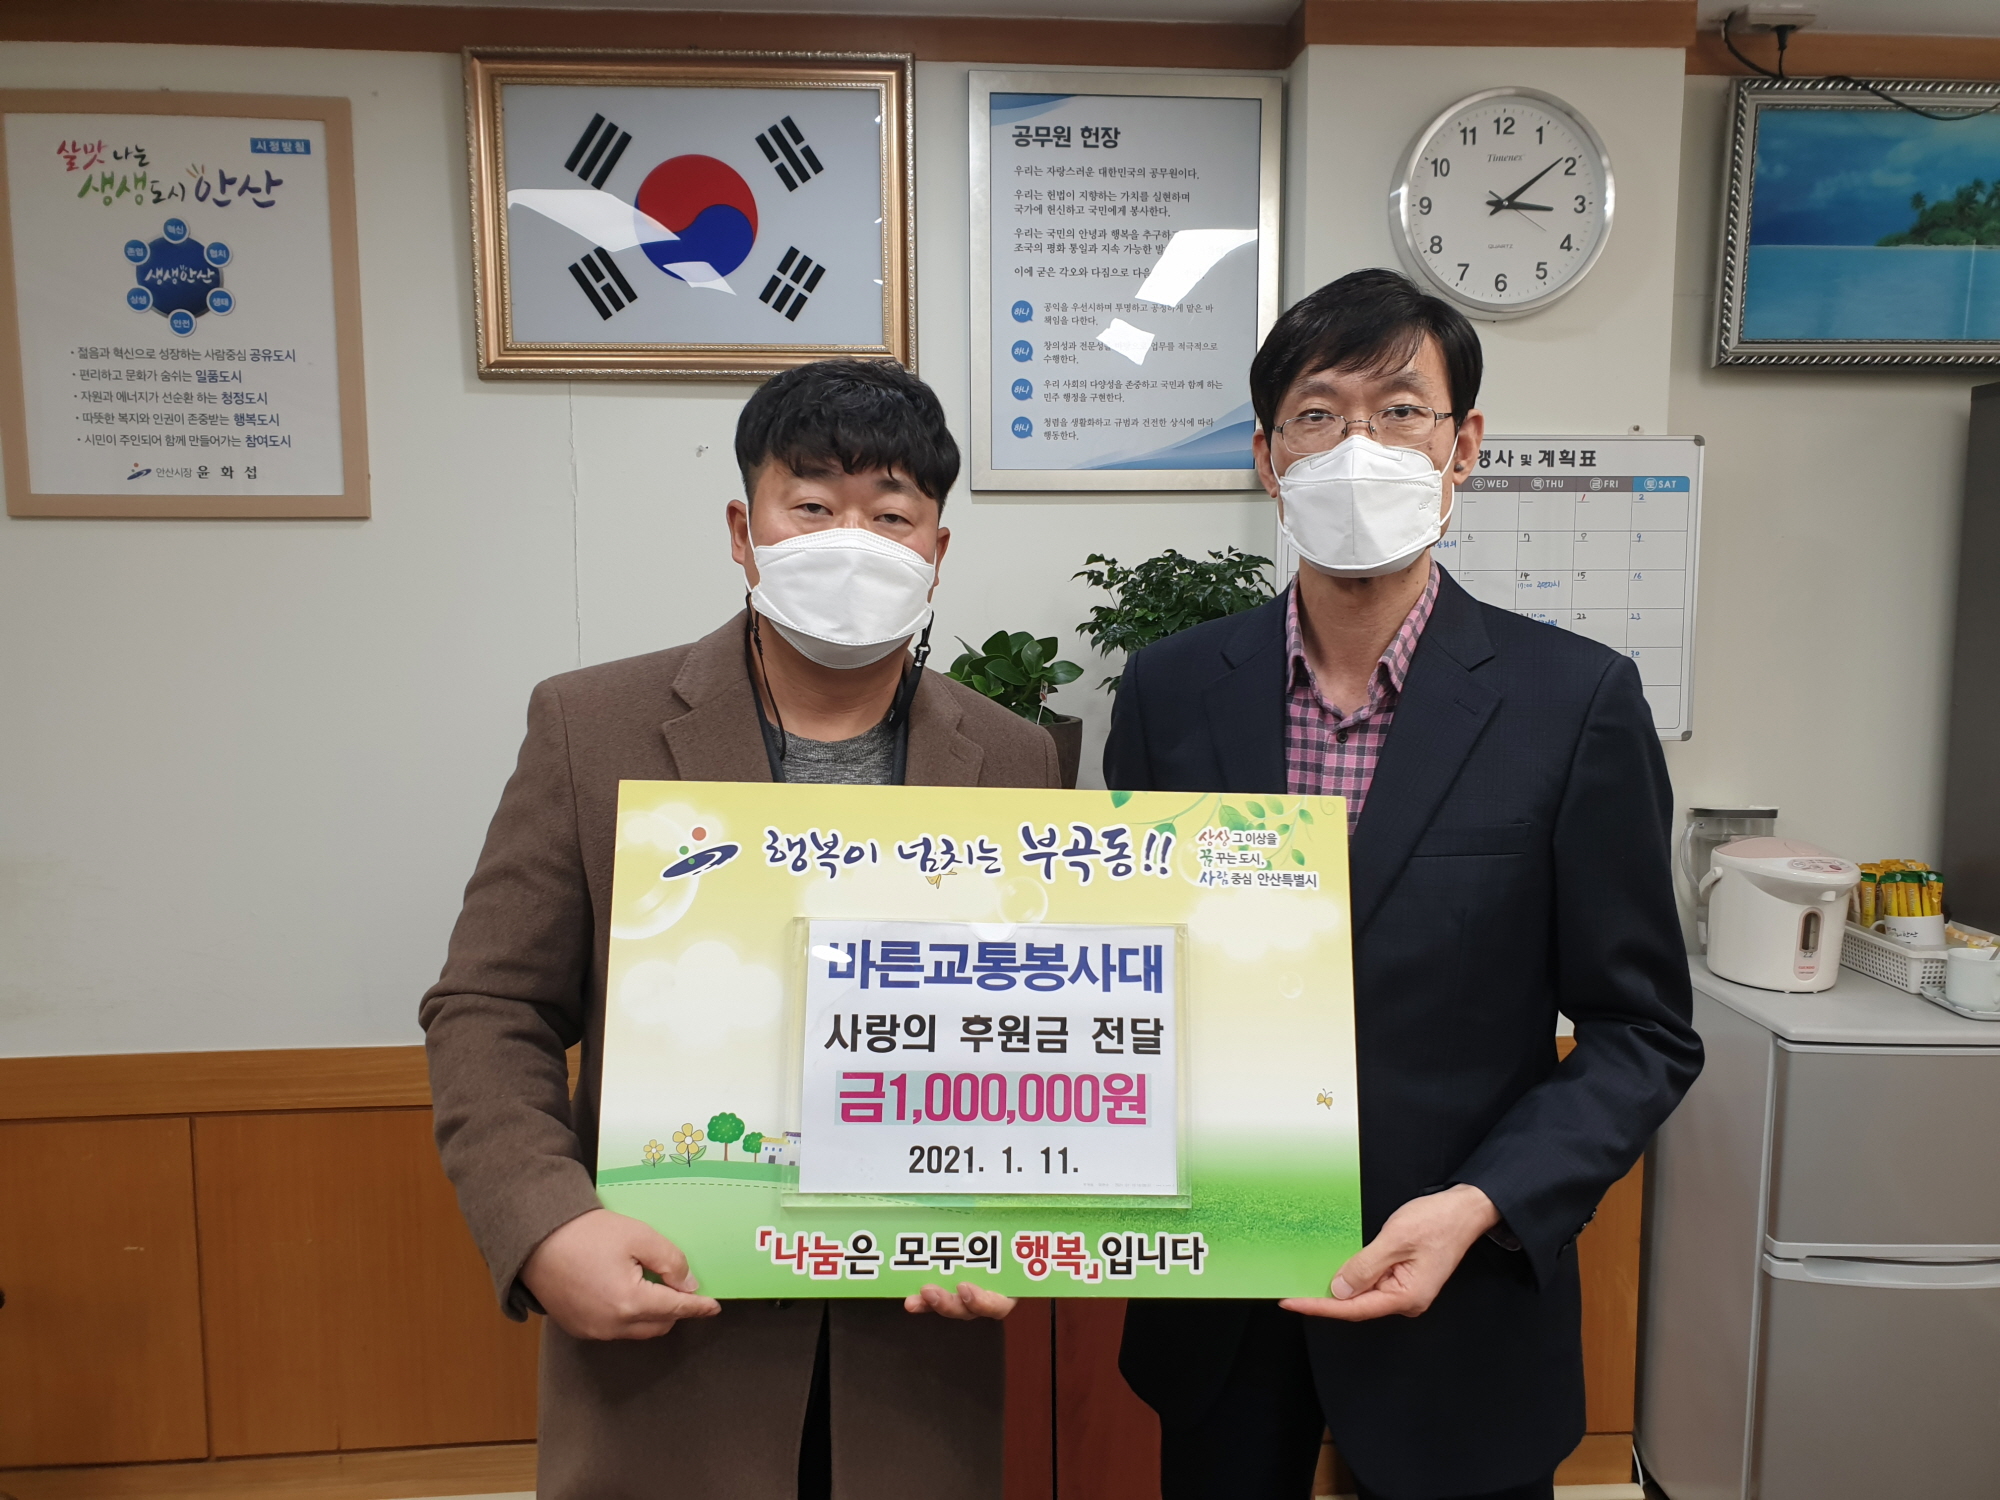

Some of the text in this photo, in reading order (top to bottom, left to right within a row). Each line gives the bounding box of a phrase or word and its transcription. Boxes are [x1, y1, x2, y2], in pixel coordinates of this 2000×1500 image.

[1493, 117, 1515, 134] 12
[1012, 125, 1121, 148] 공무원 헌장
[1460, 127, 1476, 145] 11
[1536, 126, 1543, 144] 1
[256, 140, 306, 153] 시정방침
[1487, 154, 1523, 162] Timenex
[1014, 166, 1200, 180] 우리는 자랑스러운 대한민국의 공무원이다.
[1431, 158, 1450, 177] 10
[1564, 157, 1576, 175] 2
[194, 169, 283, 208] 안산
[1014, 190, 1190, 203] 우리는 헌법이 지향하는 가치를 실현하며
[1014, 204, 1171, 218] 국가에 헌신하고 국민에게 봉사한다.
[1419, 197, 1432, 215] 9
[1574, 195, 1586, 213] 3
[1014, 228, 1175, 240] 우리는 국민의 안녕과 행복을 추구하
[1014, 243, 1043, 254] 조국의
[1046, 243, 1066, 254] 평화
[1069, 243, 1098, 255] 통일과
[1101, 244, 1120, 255] 지속
[1123, 244, 1152, 255] 가능한
[1430, 235, 1443, 254] 8
[1560, 234, 1573, 251] 4
[1014, 267, 1130, 279] 이에 굳은 각오와 다짐으로
[1457, 264, 1470, 281] 7
[1536, 262, 1548, 279] 5
[1495, 274, 1508, 292] 6
[1013, 308, 1030, 317] 하나
[1044, 303, 1068, 312] 공익을
[1071, 303, 1112, 312] 우선시하며
[1115, 303, 1148, 313] 투명하고
[1206, 304, 1213, 313] 바
[173, 319, 190, 328] 안전
[1044, 316, 1098, 326] 책임을 다한다.
[1013, 347, 1030, 356] 하나
[1044, 341, 1077, 351] 창의성과
[1151, 342, 1175, 351] 업무를
[1178, 342, 1217, 351] 적극적으로
[78, 347, 296, 362] 젊음과 혁신으로 성장하는 사람중심 공유도시
[1044, 355, 1078, 364] 수행한다.
[79, 369, 242, 383] 편리하고 문화가 숨쉬는 일품도시
[1013, 385, 1030, 394] 하나
[1044, 380, 1223, 390] 우리 사회의 다양성을 존중하고 국민과 함께 하는
[80, 391, 268, 405] 자원과 에너지가 선순환 하는 청정도시
[1044, 393, 1125, 403] 민주 행정을 구현한다.
[82, 412, 280, 426] 따뜻한 복지와 인권이 존중받는 행복도시
[1044, 418, 1214, 428] 청렴을 생활화하고 규범과 건전한 상식에 따라
[1013, 423, 1030, 432] 하나
[85, 434, 291, 448] 시민이 주인되어 함께 만들어가는 참여도시
[1044, 431, 1079, 441] 행동한다.
[1521, 454, 1532, 466] 및
[1538, 450, 1597, 467] 계획표
[155, 467, 192, 478] 안산시장
[1520, 572, 1530, 580] 14
[1633, 572, 1642, 580] 16
[1198, 829, 1230, 846] 상상
[767, 825, 1173, 882] 행복이 넘치는 부곡동!!
[1239, 853, 1264, 866] 도시,
[1200, 870, 1317, 888] 사람 중심 안산특별시
[828, 939, 1163, 994] 바른교통봉사대
[824, 1014, 1164, 1056] 사랑의 후원금 전달
[839, 1072, 1146, 1125] 금1,000,000원
[909, 1145, 1079, 1175] 2021. 1. 11.
[759, 1230, 1204, 1279] 「나눔은 모두의 행복」입니다
